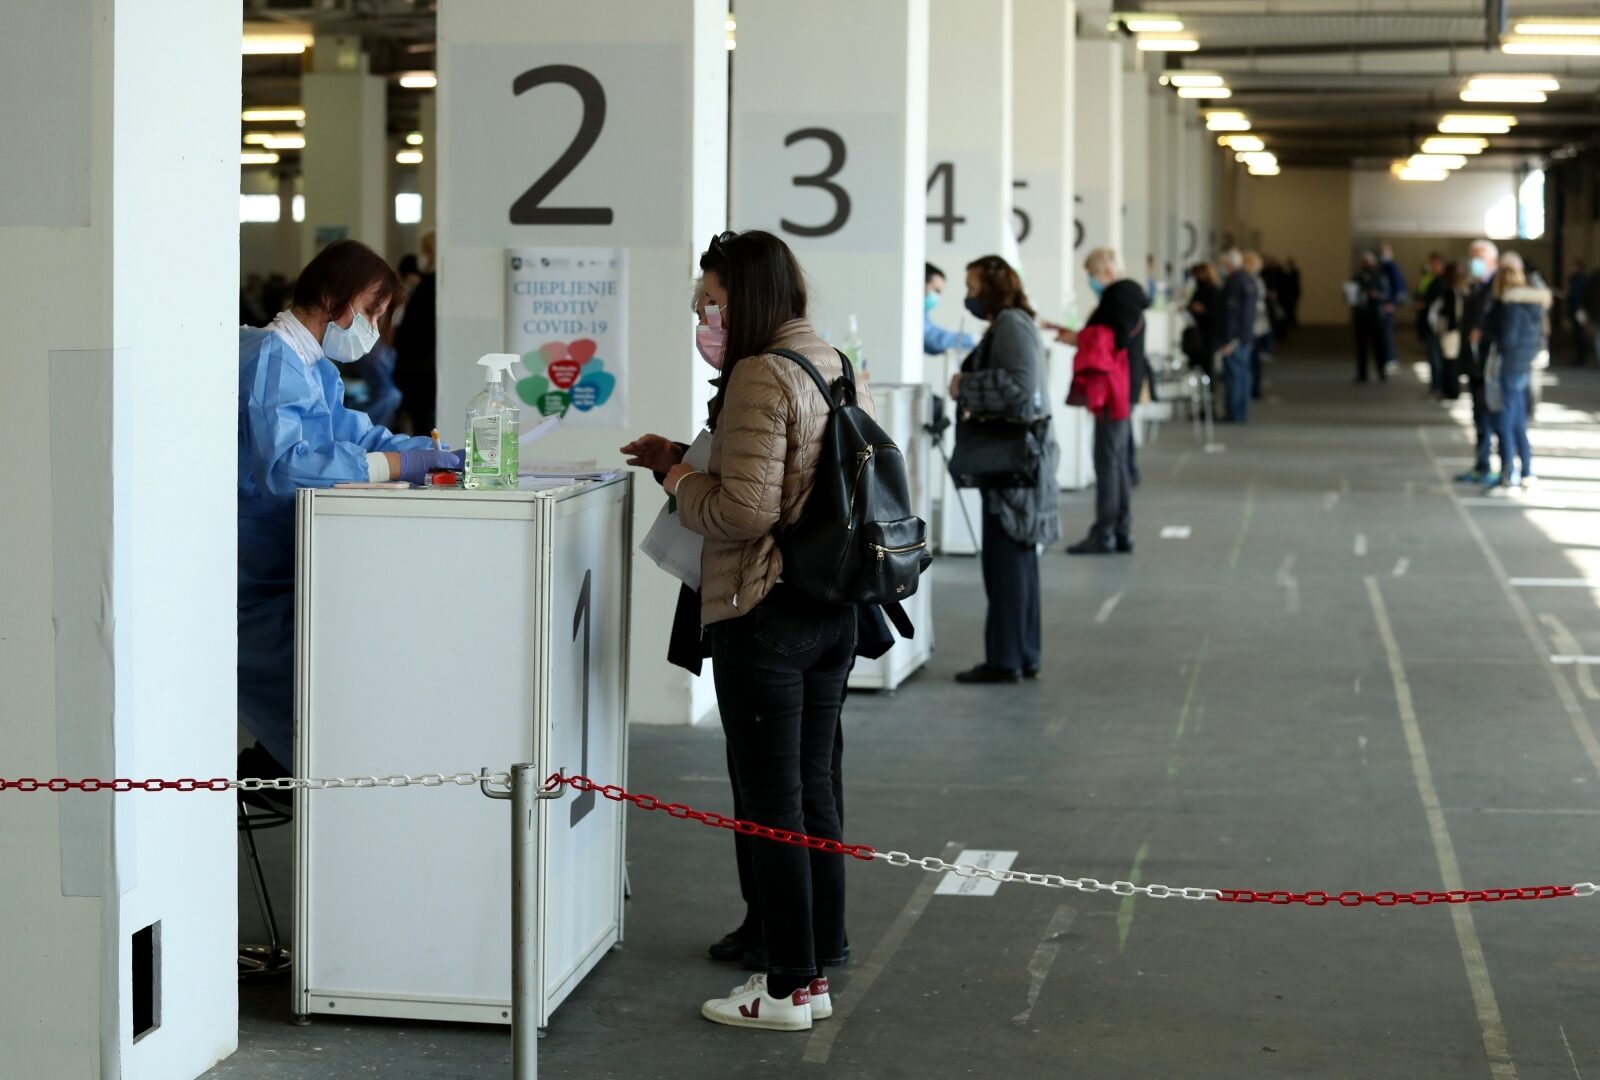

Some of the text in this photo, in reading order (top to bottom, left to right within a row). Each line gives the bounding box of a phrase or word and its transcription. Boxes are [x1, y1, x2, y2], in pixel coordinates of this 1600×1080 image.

[509, 64, 613, 225] 2
[780, 126, 852, 238] 3
[926, 162, 966, 243] 4
[513, 280, 618, 297] CIJEPLJENJE
[523, 319, 608, 335] COVID-19
[532, 300, 599, 315] PROTIV
[570, 569, 595, 828] 1
